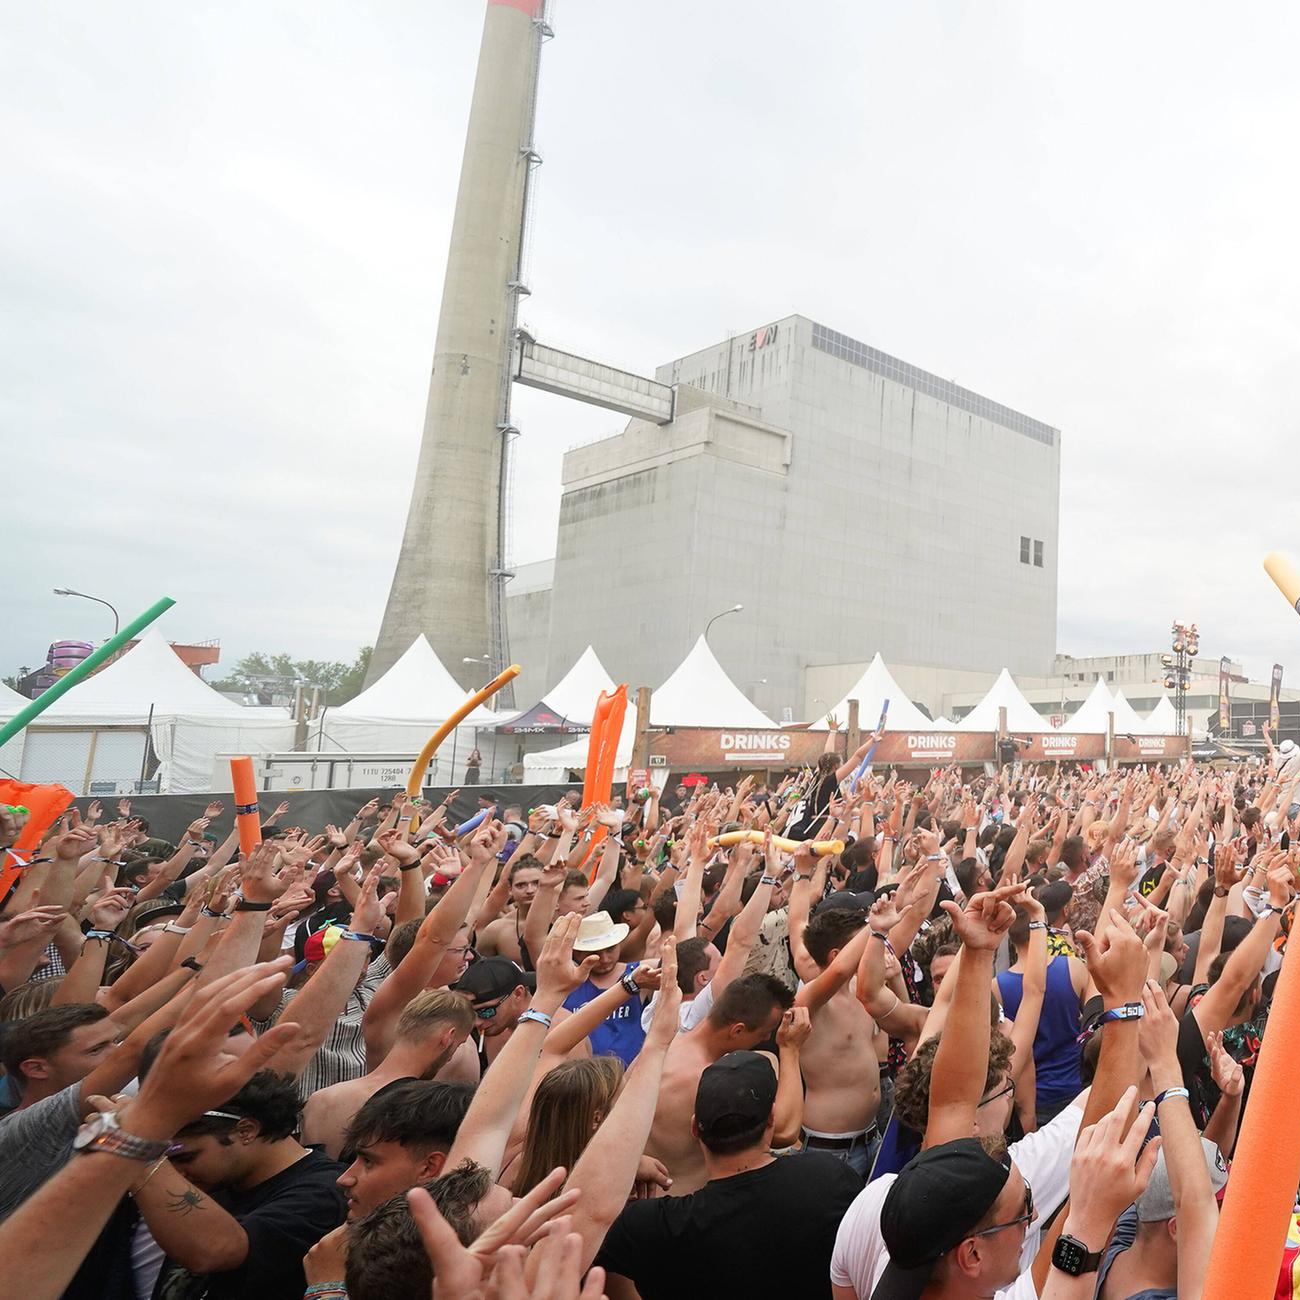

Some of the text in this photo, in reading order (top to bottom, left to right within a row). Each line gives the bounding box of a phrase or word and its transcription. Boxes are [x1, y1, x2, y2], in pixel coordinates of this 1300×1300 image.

[720, 733, 791, 750] DRINKS
[907, 735, 957, 749] DRINKS
[1041, 736, 1078, 748] DRINKS
[1138, 738, 1166, 748] DRINKS
